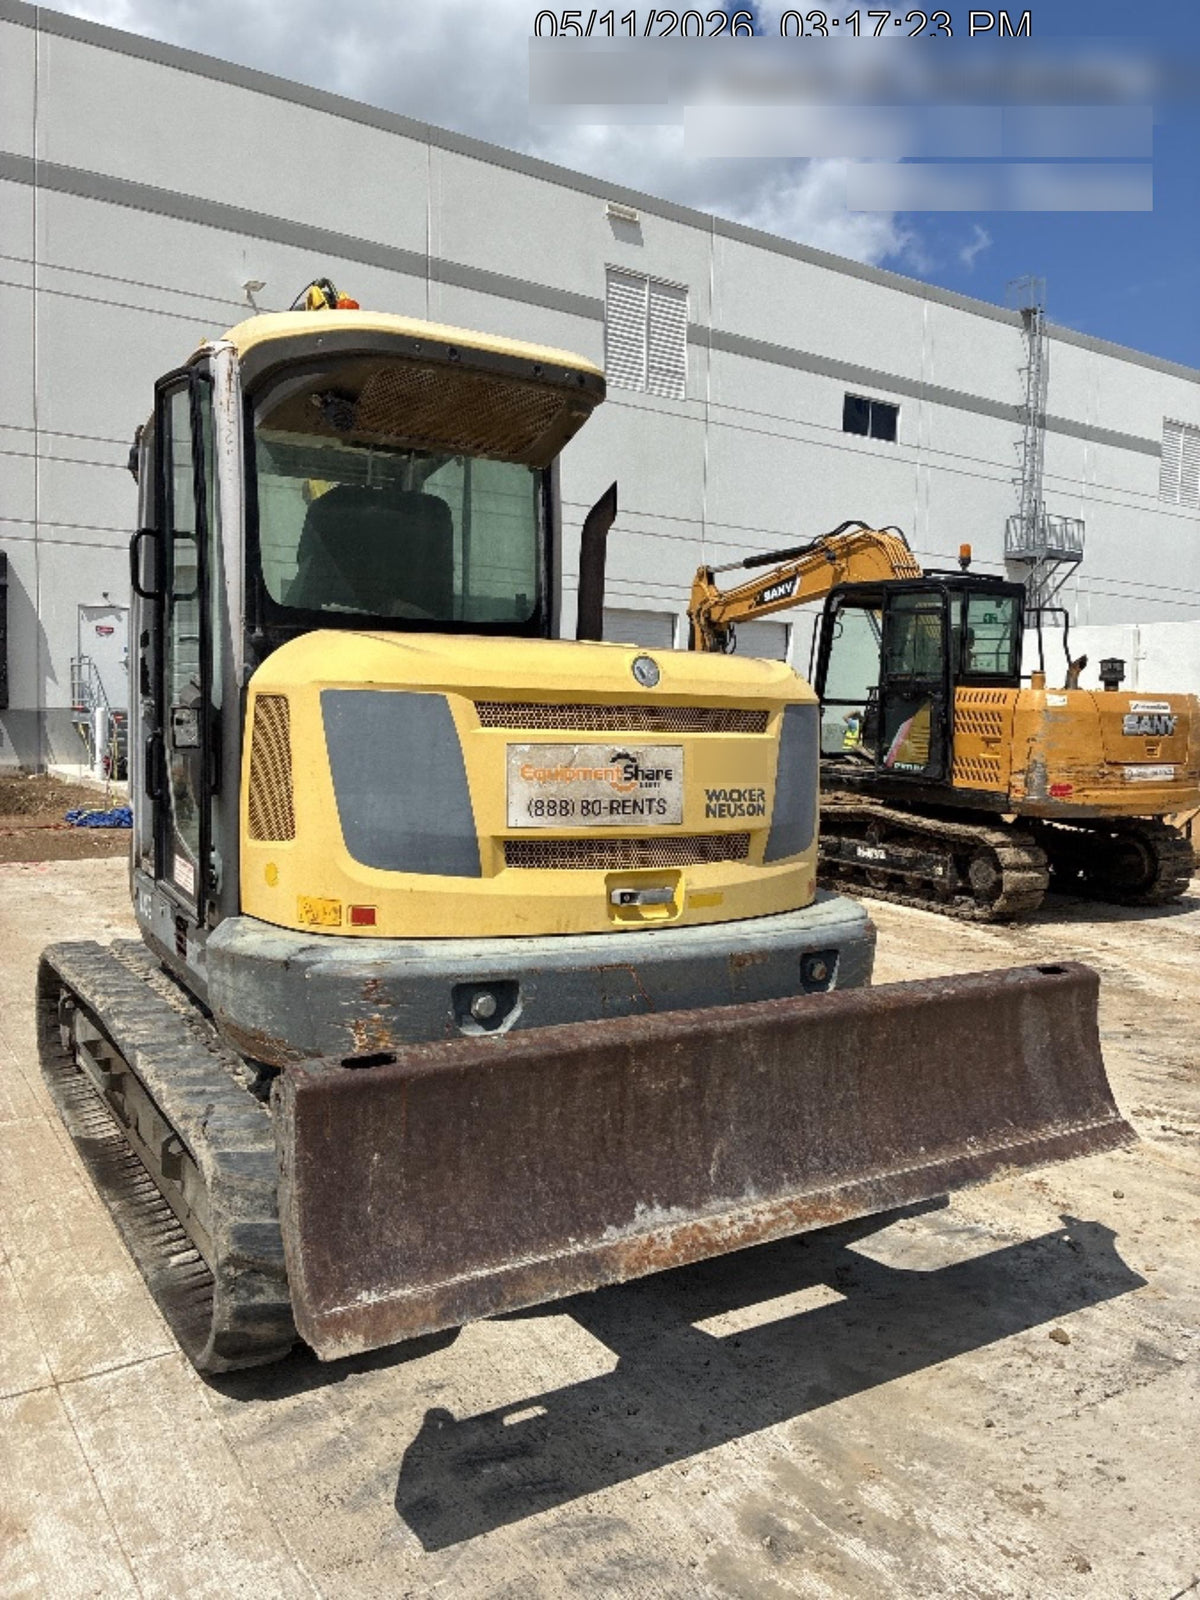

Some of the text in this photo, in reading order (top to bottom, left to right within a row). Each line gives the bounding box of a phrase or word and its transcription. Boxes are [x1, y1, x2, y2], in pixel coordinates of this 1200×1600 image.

[1122, 714, 1178, 737] SANY
[520, 764, 673, 785] EquipmentShare
[704, 788, 766, 804] WACKER
[527, 797, 667, 817] (888) 80-RENTS
[704, 802, 766, 819] NEUSON
